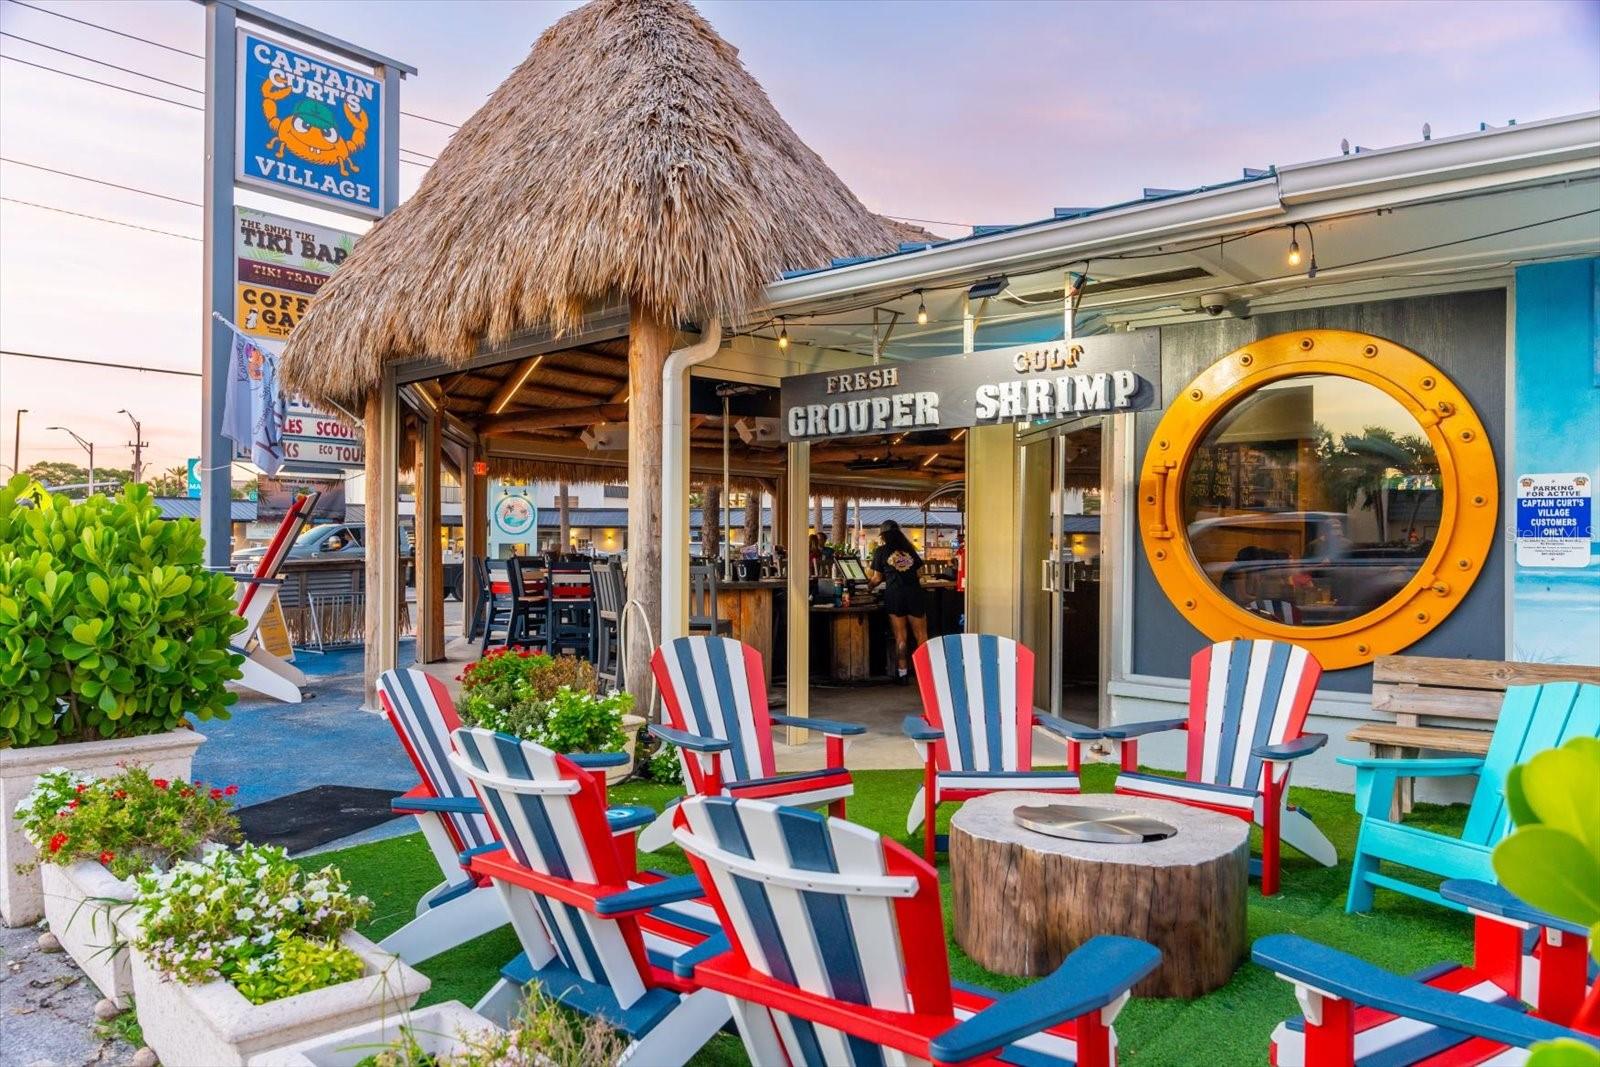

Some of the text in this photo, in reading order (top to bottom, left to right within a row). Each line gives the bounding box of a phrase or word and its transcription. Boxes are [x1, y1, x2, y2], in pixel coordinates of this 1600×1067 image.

[254, 44, 374, 100] CAPTAIN
[269, 68, 361, 113] CURT'S
[255, 155, 371, 203] VILLAGE
[241, 219, 315, 241] THE SNIKI TIKI
[241, 227, 293, 255] TIKI
[253, 264, 281, 278] TIKI
[262, 309, 303, 328] GA
[1013, 345, 1084, 373] GULF
[826, 367, 899, 394] FRESH
[975, 370, 1139, 420] SHRIMP
[788, 391, 940, 437] GROUPER
[319, 445, 333, 455] ECO
[1522, 499, 1584, 507] CAPTAIN CURT'S
[1538, 508, 1570, 516] VILLAGE
[1530, 518, 1577, 526] CUSTOMERS
[1543, 527, 1564, 535] ONLY
